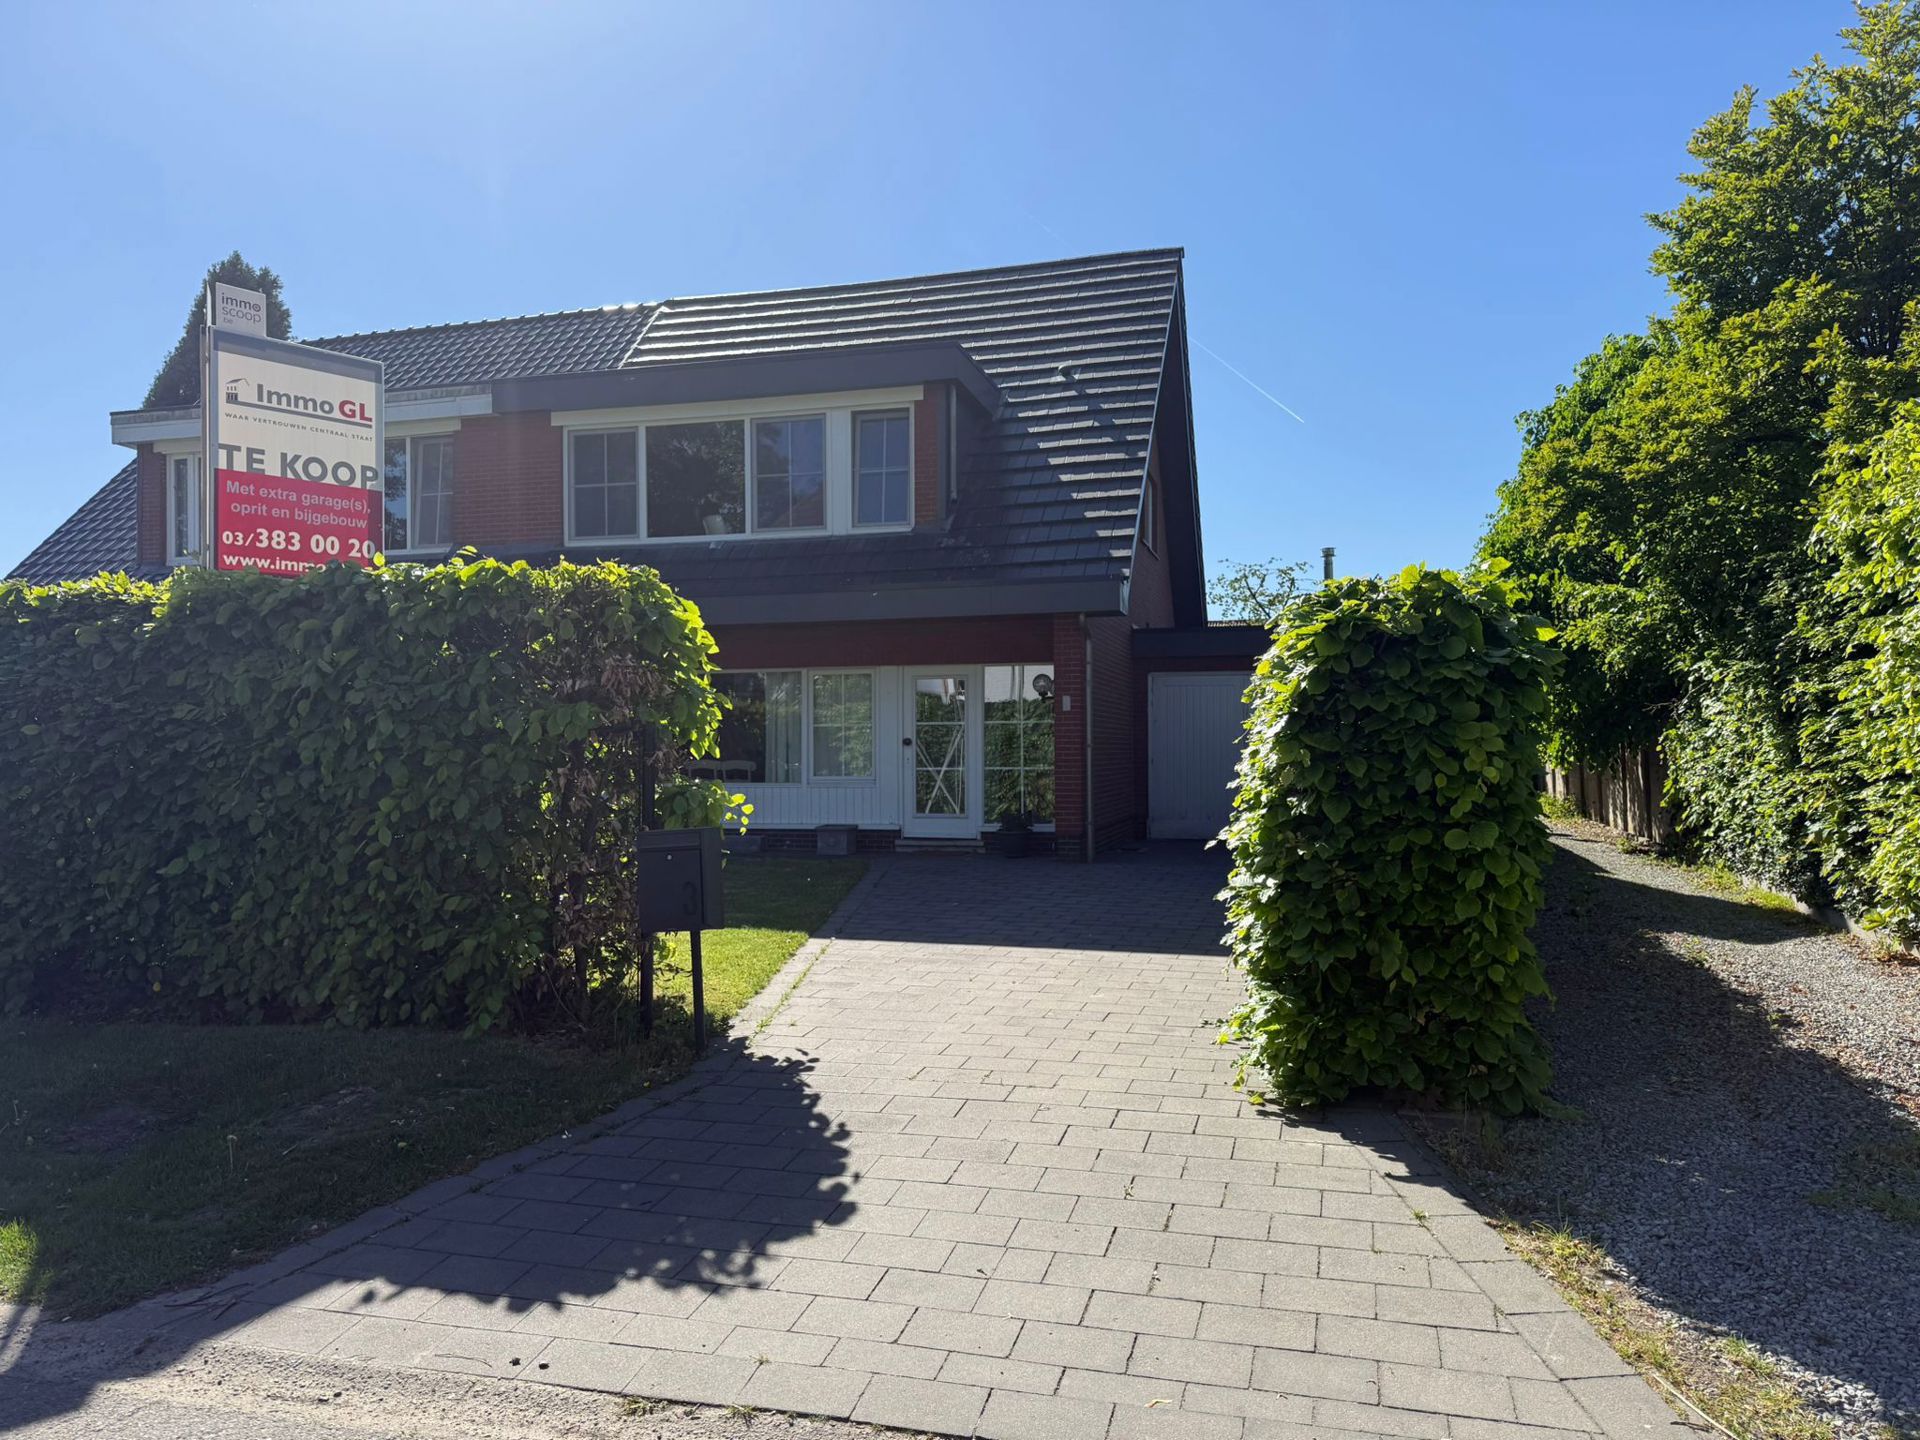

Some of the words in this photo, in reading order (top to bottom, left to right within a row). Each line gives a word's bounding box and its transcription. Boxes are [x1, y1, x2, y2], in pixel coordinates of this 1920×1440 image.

[221, 292, 261, 312] immo
[221, 306, 261, 324] scoop
[225, 412, 249, 421] WAAR
[253, 417, 307, 431] VERTROUWEN
[310, 426, 348, 438] CENTRAAL
[351, 433, 373, 442] STAAT
[218, 443, 266, 475] TE
[280, 452, 379, 489] KOOP
[226, 480, 256, 495] Met
[259, 488, 297, 502] extra
[301, 493, 371, 514] garage(s),
[231, 502, 268, 516] oprit
[272, 508, 290, 519] en
[294, 509, 368, 529] bijgebouw
[222, 528, 301, 551] 03/383
[310, 534, 340, 555] 00
[348, 539, 376, 559] 20
